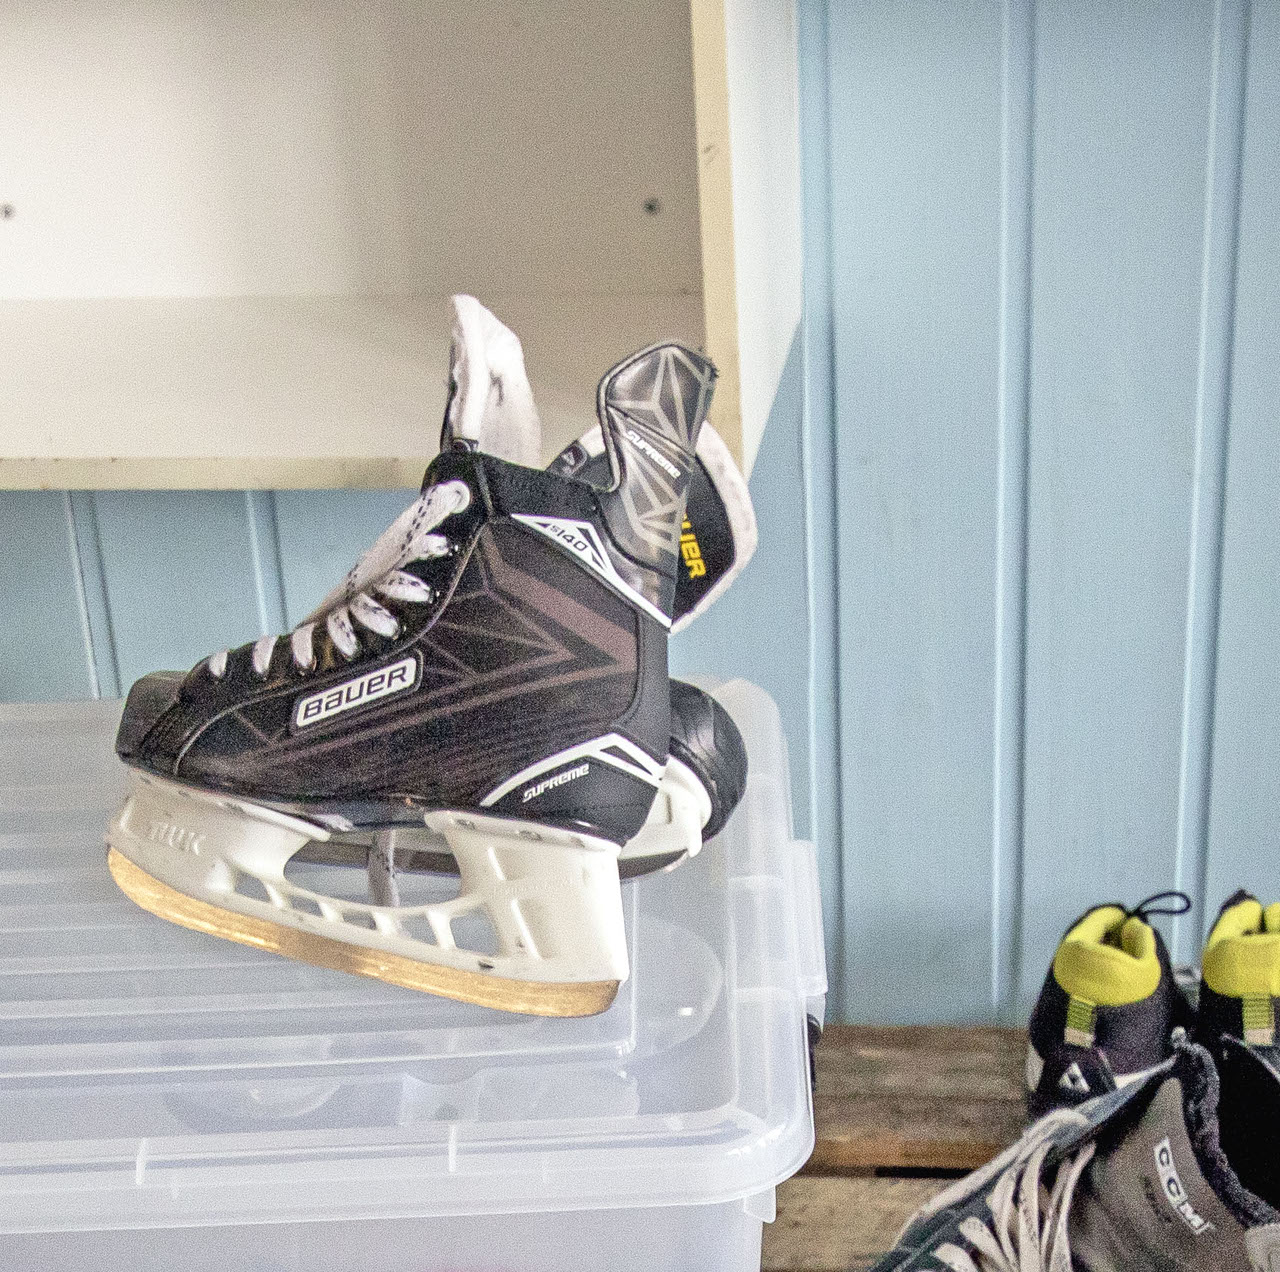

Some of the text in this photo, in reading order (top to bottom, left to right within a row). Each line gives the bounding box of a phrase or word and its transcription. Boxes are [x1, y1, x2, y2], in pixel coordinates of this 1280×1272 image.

[626, 430, 681, 479] SUPREME
[302, 665, 407, 720] BAUER
[522, 763, 590, 803] SUPREME
[1156, 1142, 1209, 1231] CCM
